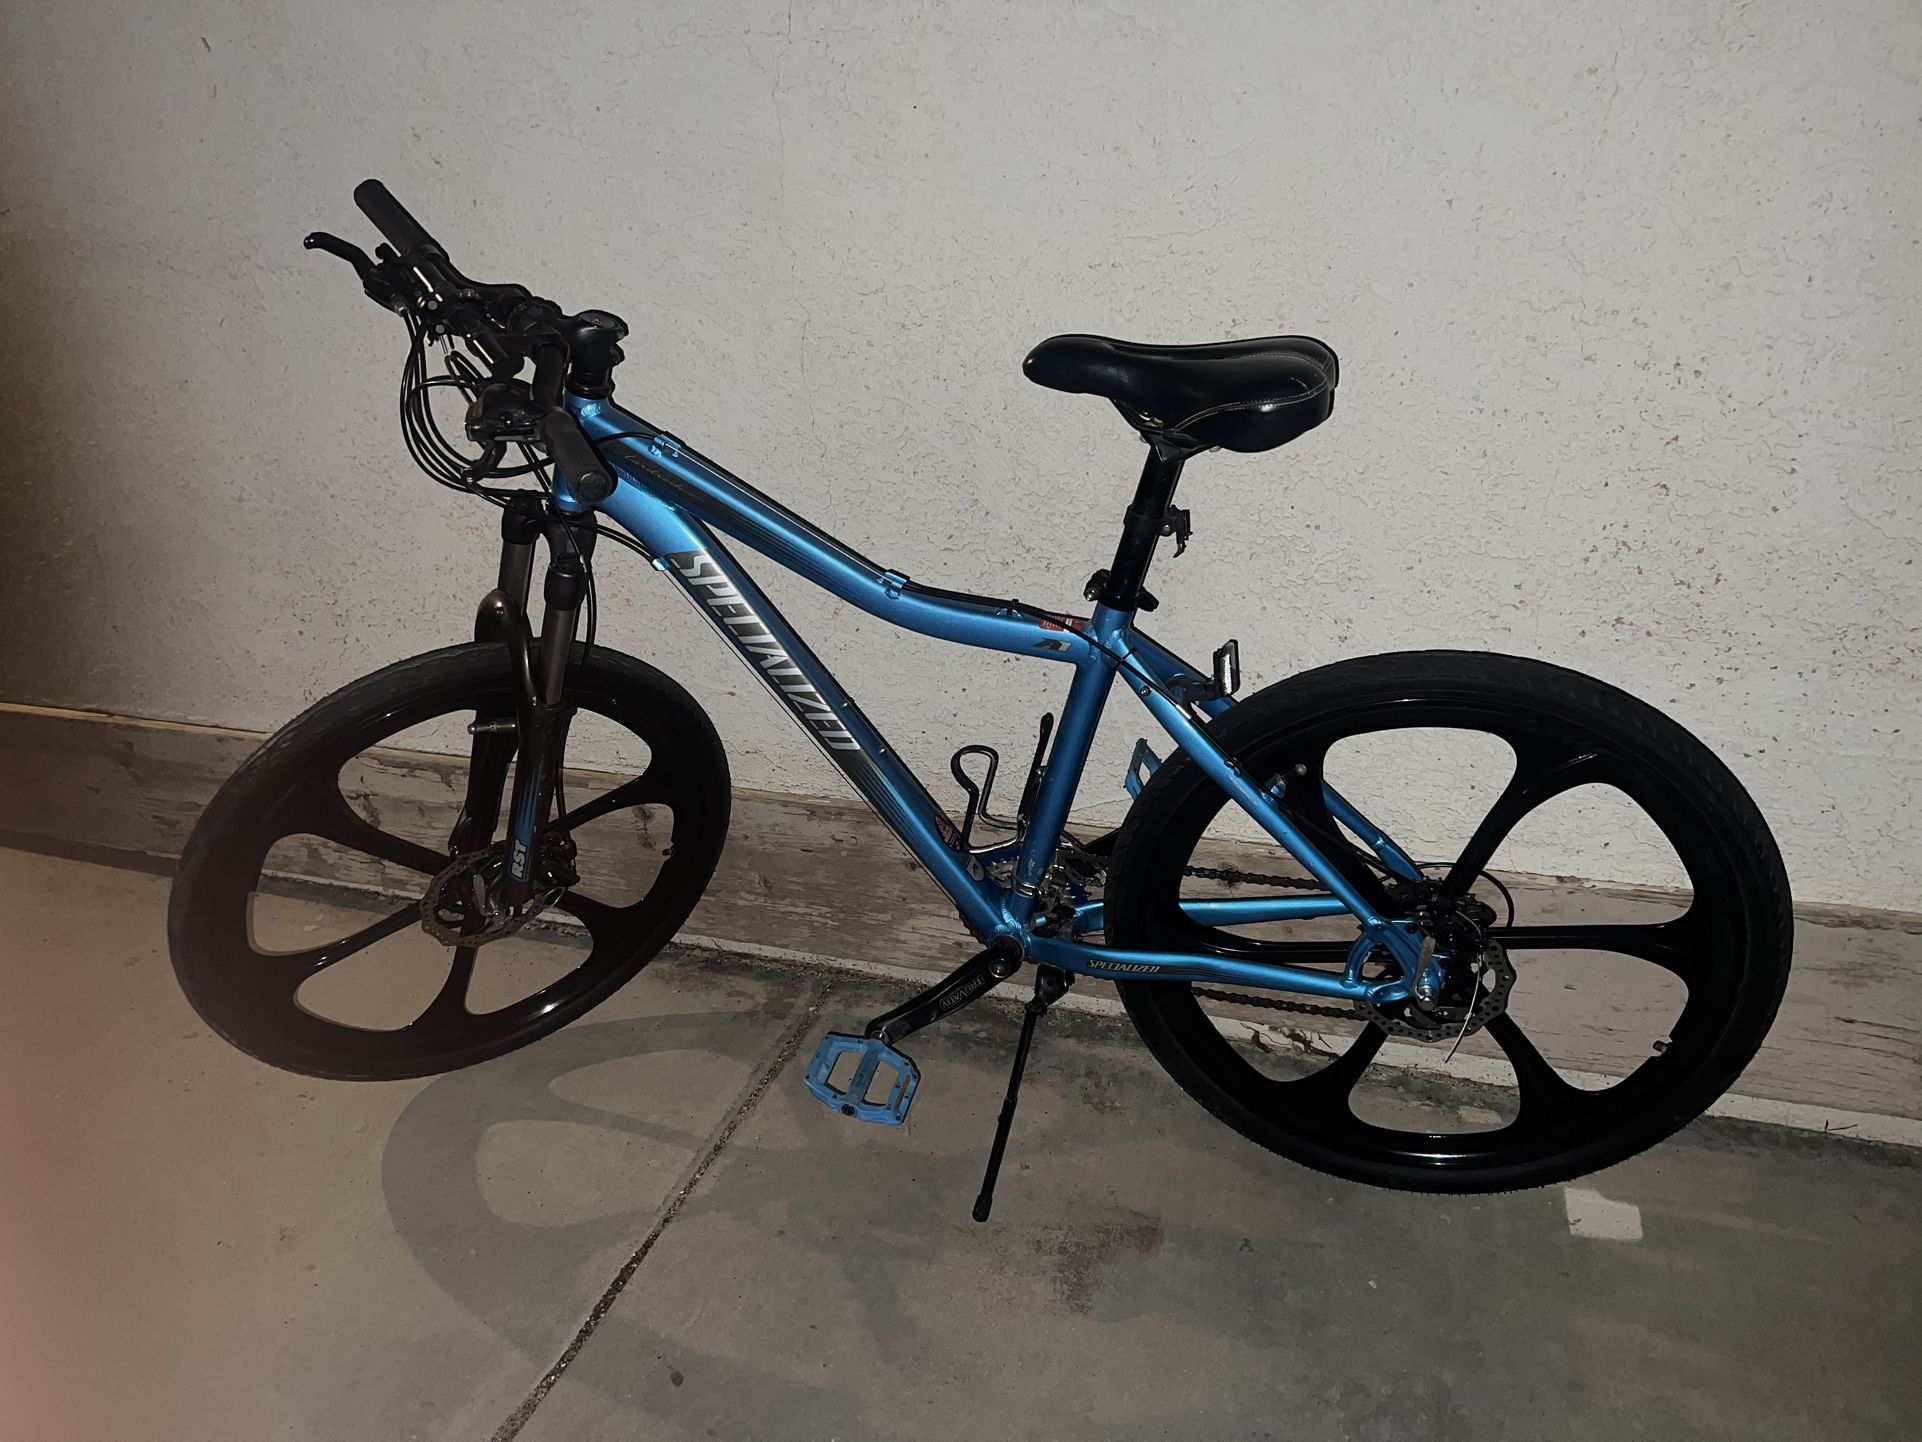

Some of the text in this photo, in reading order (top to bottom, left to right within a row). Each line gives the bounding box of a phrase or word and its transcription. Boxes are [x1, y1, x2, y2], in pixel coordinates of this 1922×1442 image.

[669, 554, 861, 750] SPECIALIZED
[511, 837, 527, 879] RST
[1087, 959, 1161, 973] SPECIALIZED
